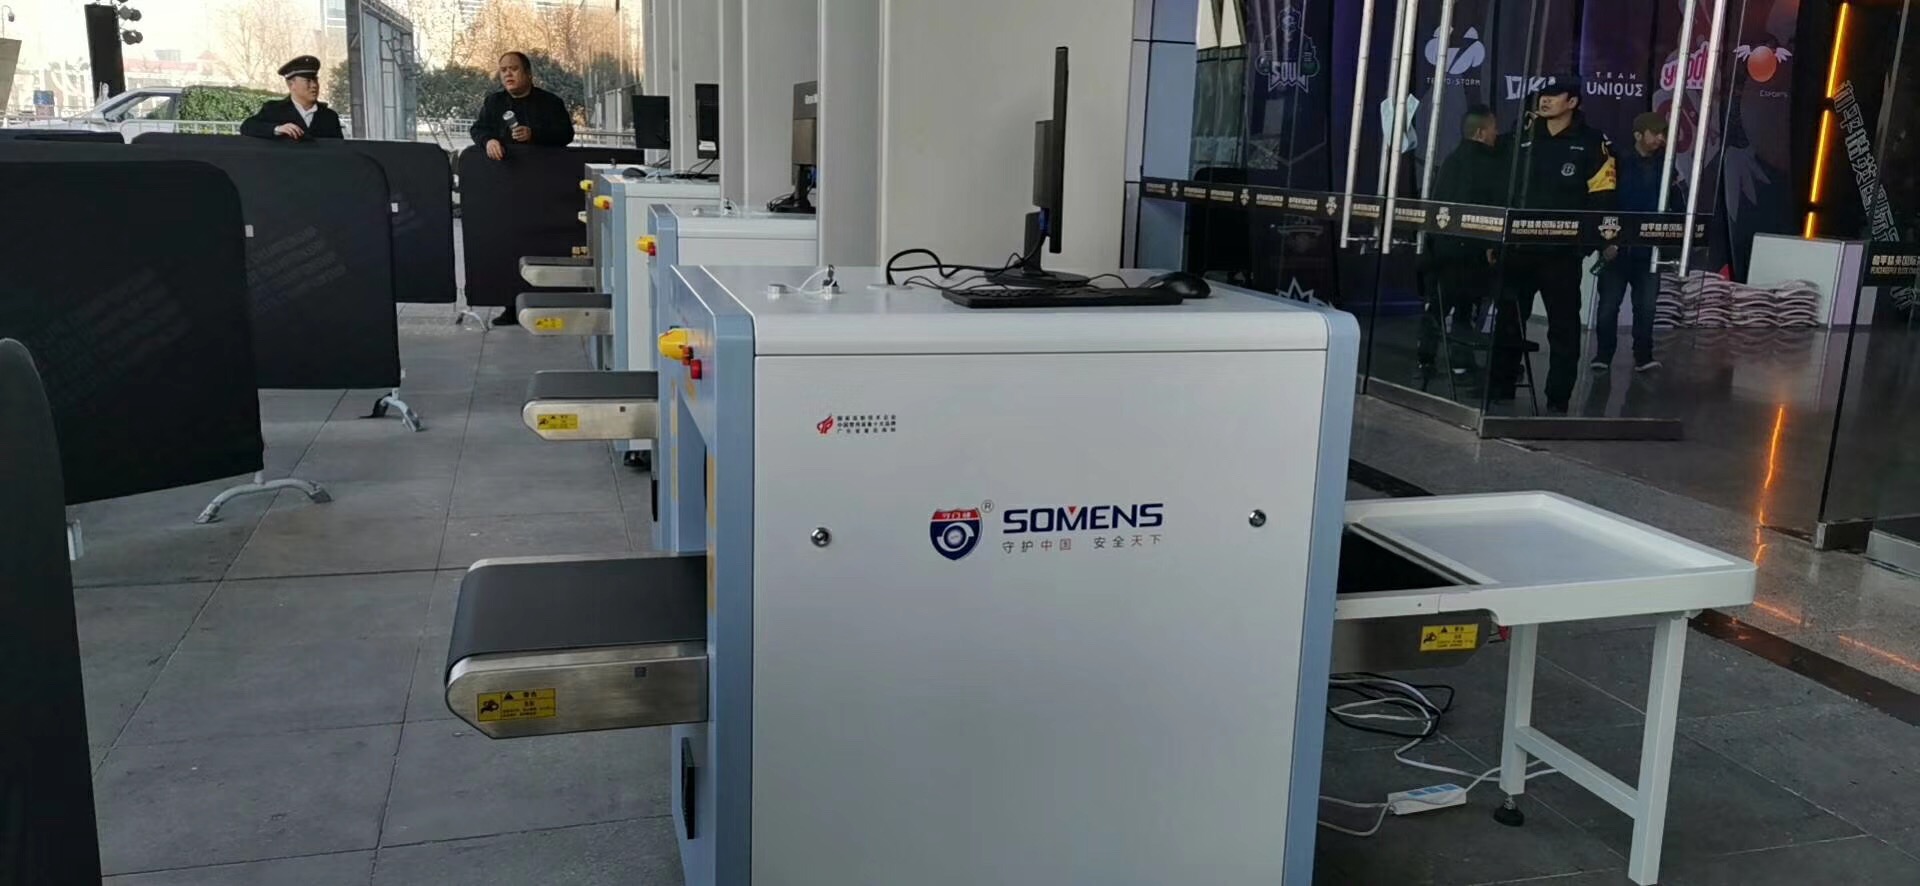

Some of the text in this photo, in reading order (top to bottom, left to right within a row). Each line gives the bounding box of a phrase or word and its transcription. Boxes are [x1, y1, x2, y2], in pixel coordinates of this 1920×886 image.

[1595, 71, 1637, 80] TEAM
[1003, 503, 1164, 534] SOMENS
[1002, 533, 1162, 554] 守护中国 安全天下
